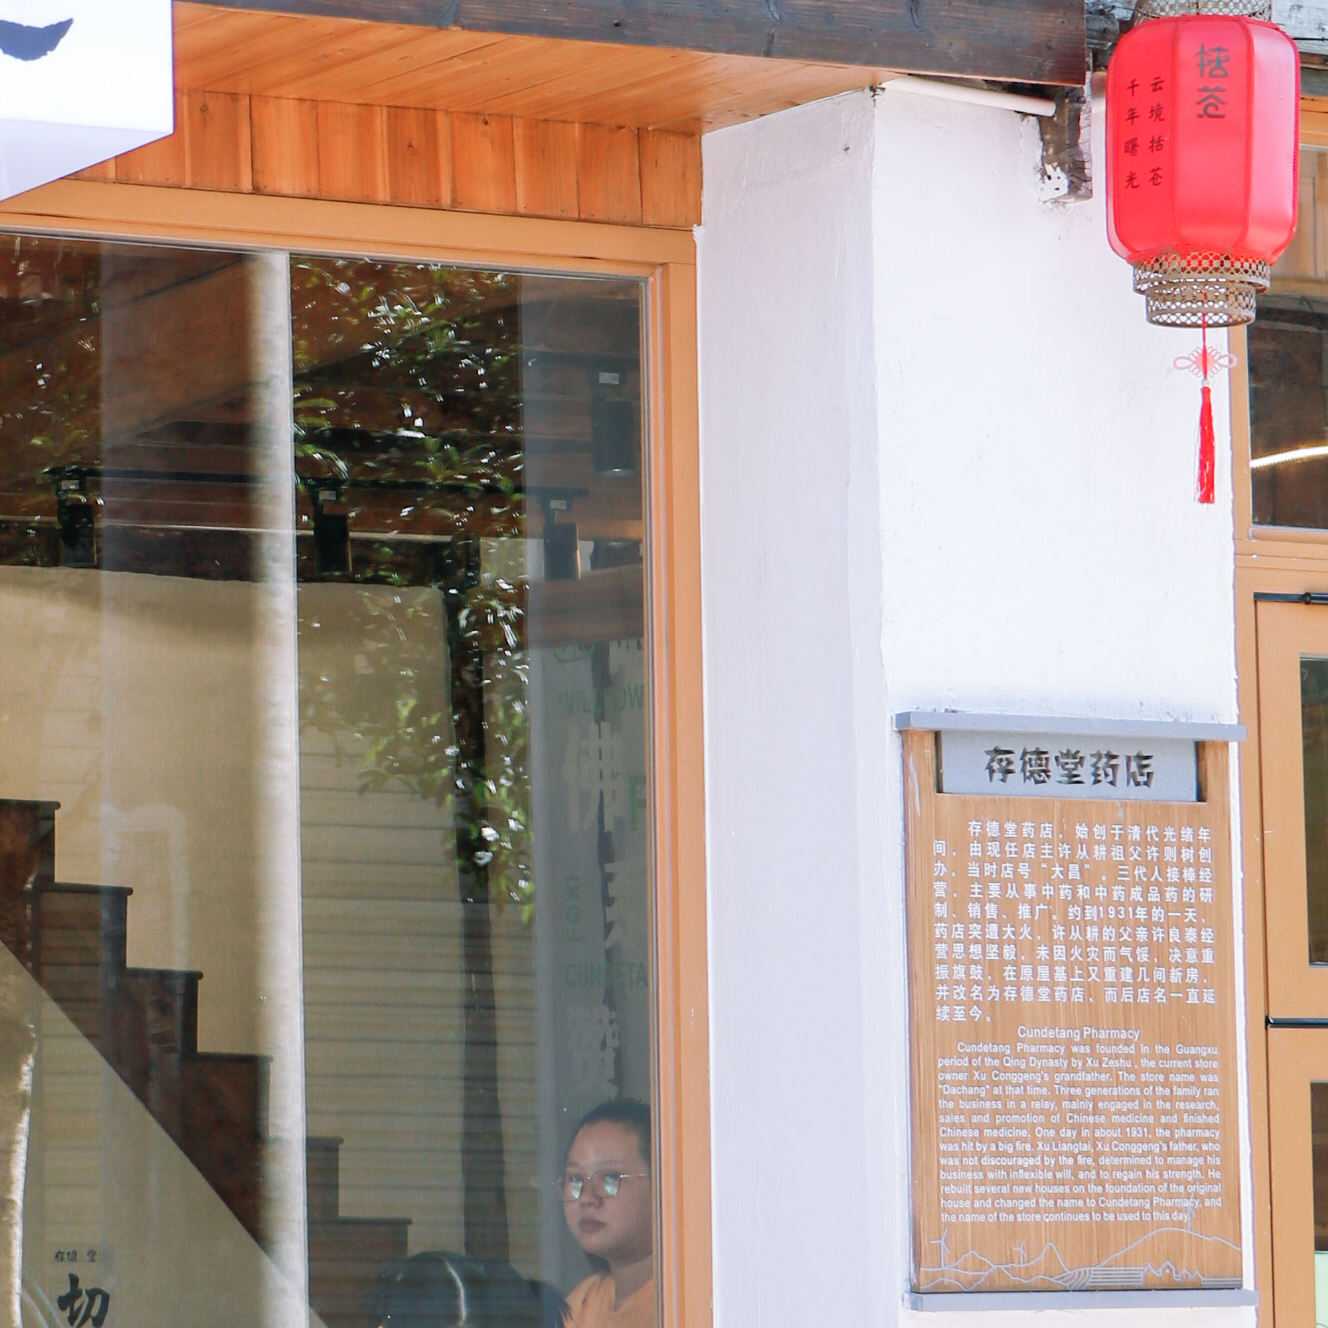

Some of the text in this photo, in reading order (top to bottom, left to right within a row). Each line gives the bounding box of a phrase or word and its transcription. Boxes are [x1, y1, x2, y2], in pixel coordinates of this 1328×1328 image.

[984, 745, 1156, 789] 存德堂药店
[936, 1004, 992, 1022] 续至今。
[1018, 1026, 1140, 1041] Cundetang Pharmacy
[957, 1042, 1218, 1056] Cundetang Pharmacy was founded in the Guangxu
[938, 1056, 1219, 1069] period of the Qing Dynasty by Xu Zeshu the current store
[938, 1072, 968, 1080] owner
[973, 1070, 986, 1081] Xu
[1118, 1071, 1136, 1081] The
[1140, 1072, 1164, 1082] store
[1170, 1074, 1196, 1082] name
[1200, 1074, 1219, 1082] was
[993, 1086, 1003, 1095] at
[1005, 1085, 1024, 1095] that
[1054, 1084, 1082, 1095] Three
[1084, 1086, 1141, 1098] generations
[1143, 1085, 1153, 1095] of
[1155, 1086, 1170, 1096] the
[1173, 1086, 1201, 1098] family
[1204, 1088, 1219, 1096] ran
[938, 1098, 955, 1109] the
[959, 1099, 1003, 1109] business
[1007, 1099, 1016, 1108] in
[1020, 1101, 1027, 1109] a
[1062, 1099, 1094, 1111] mainly
[1098, 1100, 1139, 1112] engaged
[1143, 1100, 1152, 1109] in
[1156, 1100, 1171, 1109] the
[939, 1113, 1220, 1125] sales and promotion of Chinese medicine and finished
[939, 1126, 980, 1137] Chinese
[1035, 1126, 1056, 1138] One
[1060, 1127, 1077, 1139] day
[1081, 1128, 1090, 1137] in
[1094, 1128, 1121, 1137] about
[1156, 1128, 1171, 1137] the
[1174, 1128, 1220, 1139] pharmacy
[939, 1143, 960, 1151] was
[961, 1141, 974, 1151] hit
[976, 1141, 988, 1153] by
[990, 1143, 996, 1151] a
[998, 1141, 1014, 1153] big
[1037, 1141, 1050, 1151] Xu
[1096, 1141, 1110, 1151] Xu
[1201, 1142, 1221, 1151] who
[940, 1157, 960, 1165] was
[962, 1156, 979, 1165] not
[981, 1155, 1042, 1168] discouraged
[1044, 1155, 1056, 1167] by
[1058, 1155, 1074, 1165] the
[1098, 1155, 1152, 1165] determined
[1154, 1156, 1164, 1165] to
[1167, 1157, 1204, 1167] manage
[1207, 1155, 1221, 1165] his
[940, 1169, 984, 1180] business
[987, 1169, 1007, 1179] with
[1010, 1169, 1053, 1180] inflexible
[1078, 1169, 1096, 1179] and
[1100, 1170, 1110, 1179] to
[1112, 1169, 1142, 1181] regain
[1146, 1168, 1160, 1179] his
[1208, 1169, 1221, 1179] He
[940, 1182, 1222, 1196] rebuilt several new houses on the foundation of the original
[940, 1198, 971, 1209] house
[973, 1198, 992, 1208] and
[994, 1198, 1036, 1210] changed
[1038, 1197, 1054, 1207] the
[1057, 1199, 1084, 1208] name
[1086, 1198, 1096, 1207] to
[1098, 1197, 1150, 1209] Cundetang
[1204, 1197, 1222, 1206] and
